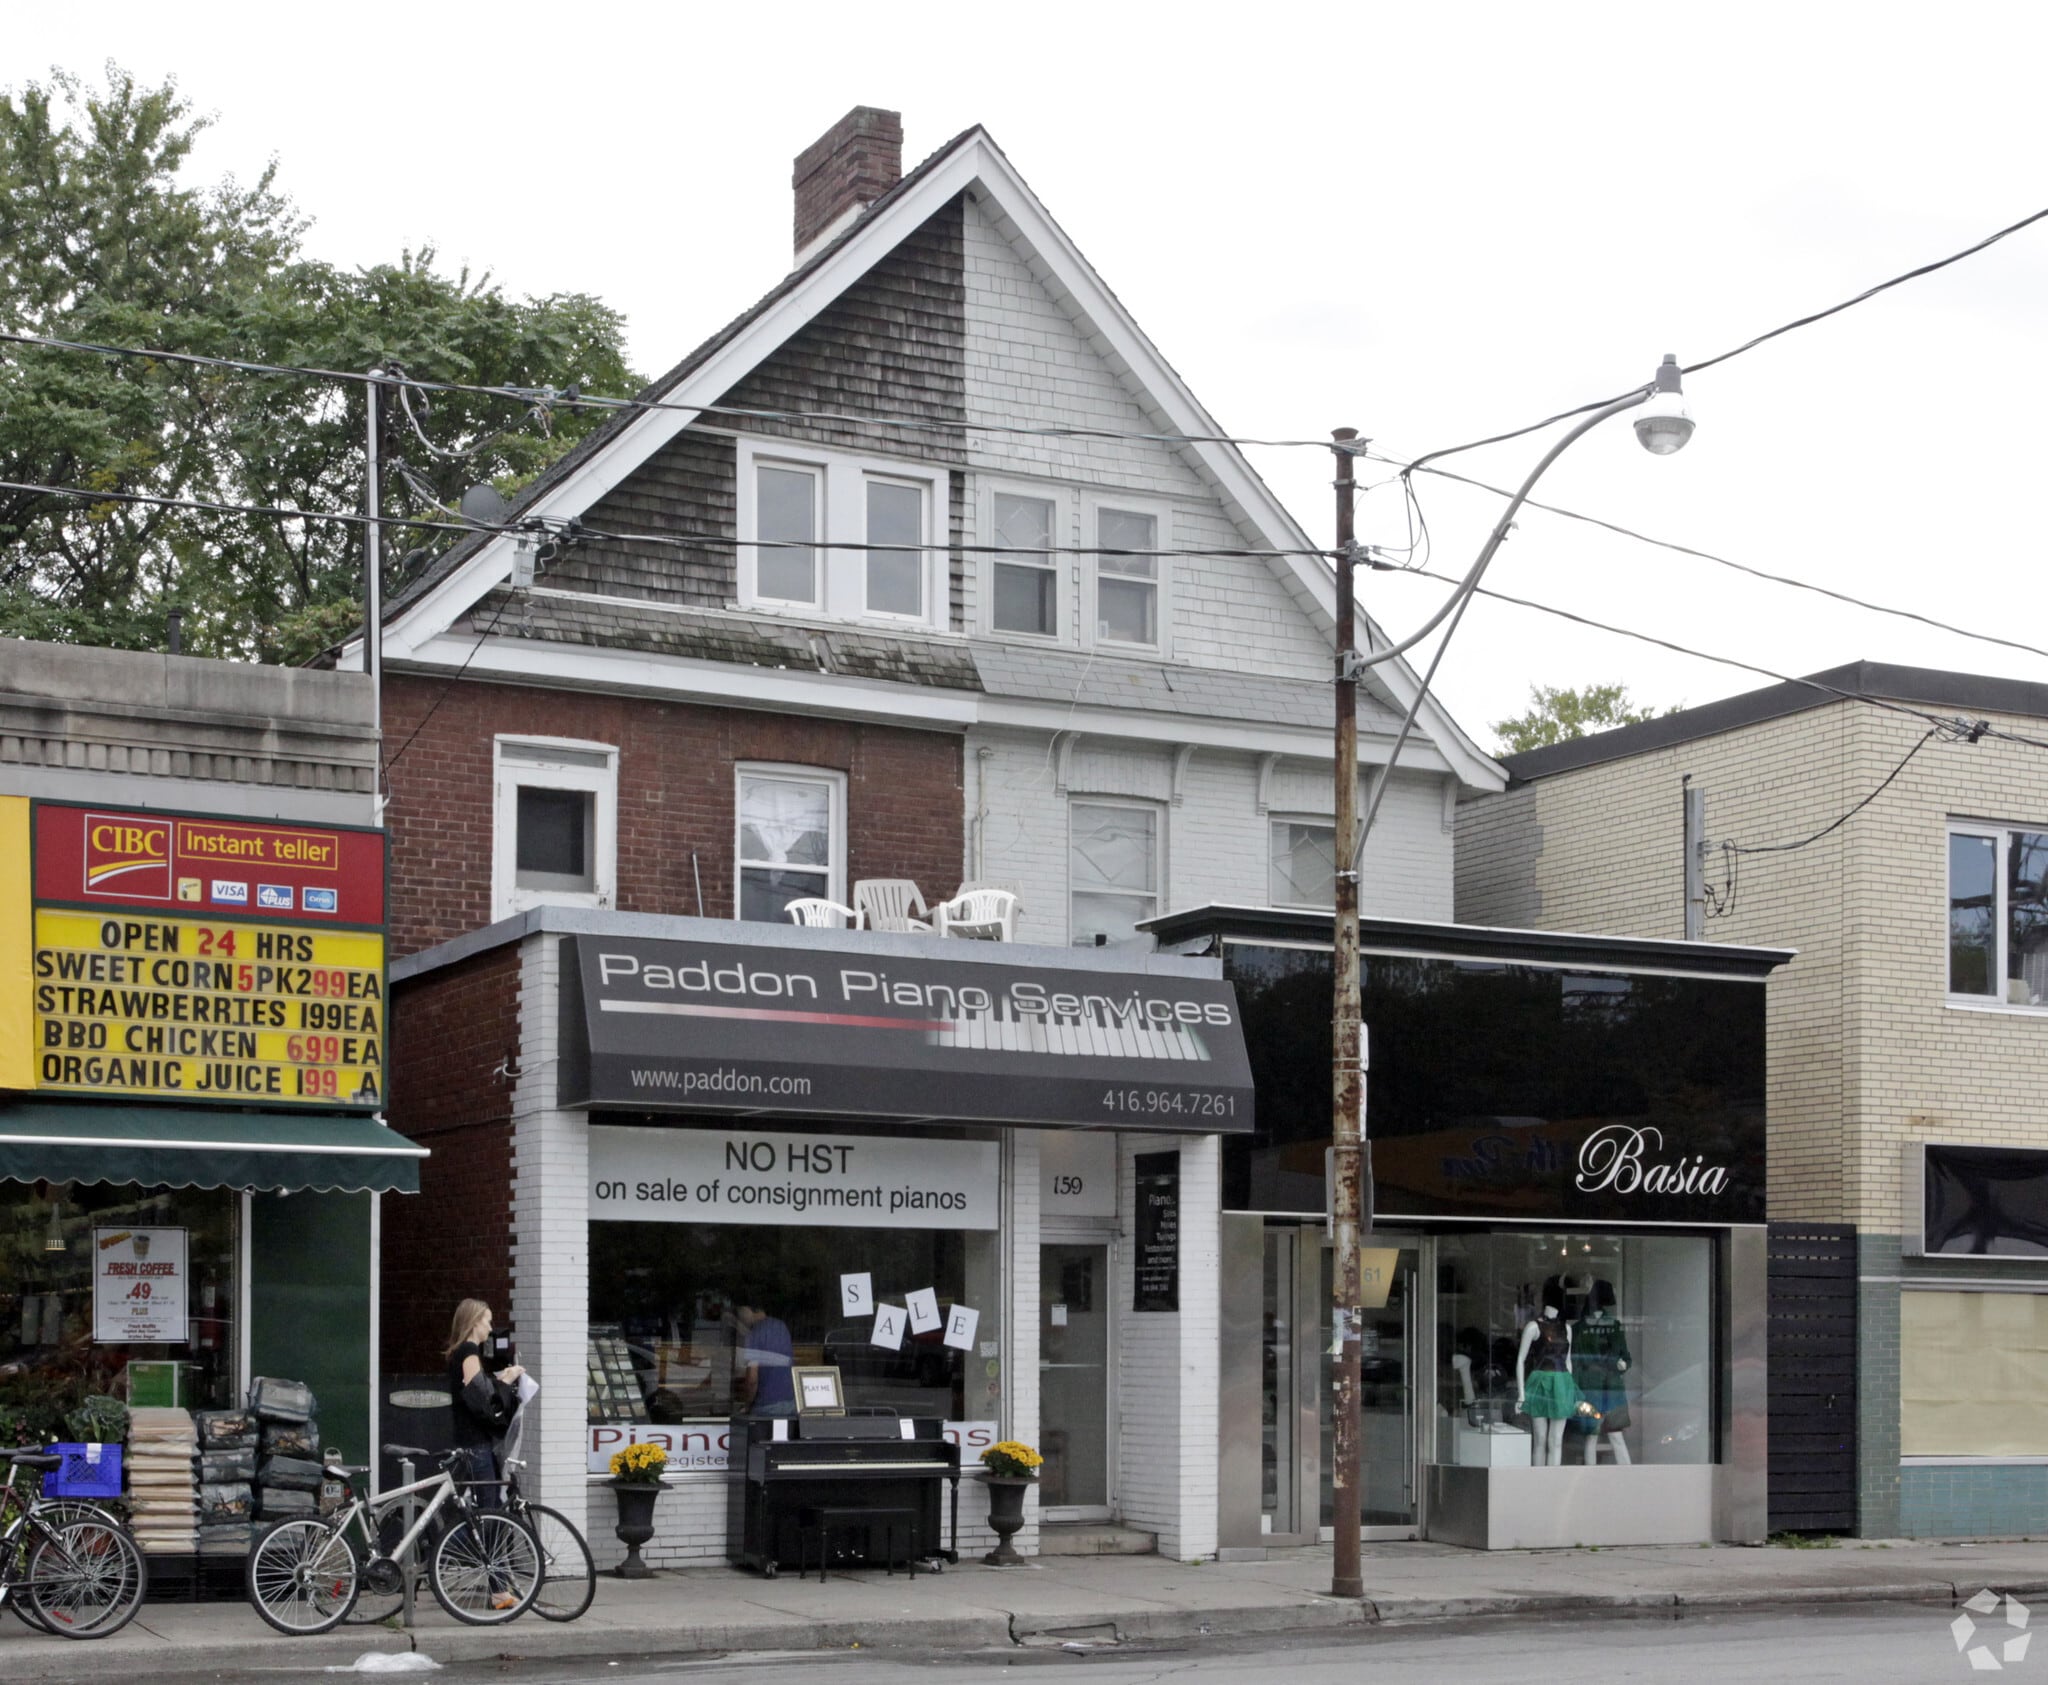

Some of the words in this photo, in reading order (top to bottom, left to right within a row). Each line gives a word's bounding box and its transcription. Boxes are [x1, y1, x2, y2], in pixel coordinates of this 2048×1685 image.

[92, 825, 165, 857] CIBC
[187, 830, 264, 857] Instant
[273, 839, 331, 861] teller
[216, 884, 246, 896] VISA
[268, 895, 291, 906] PLUS
[101, 921, 179, 953] OPEN
[198, 927, 236, 957] 24
[256, 932, 313, 962] HRS
[36, 950, 145, 984] SWEET
[37, 985, 286, 1027] STRAWBERRIES
[599, 953, 818, 999] Paddon
[840, 969, 990, 1011] Piano
[1011, 982, 1233, 1026] Services
[125, 1025, 257, 1059] CHICKEN
[42, 1053, 182, 1089] ORGANIC
[196, 1063, 281, 1093] JUICE
[631, 1067, 812, 1096] www.paddon.com
[1102, 1089, 1235, 1117] 416.964.7261
[725, 1141, 776, 1172] NO
[787, 1143, 855, 1174] HST
[1575, 1124, 1729, 1195] Basia
[595, 1180, 627, 1201] on
[635, 1177, 688, 1202] sale
[696, 1178, 720, 1203] of
[727, 1181, 883, 1212] consignment
[890, 1185, 967, 1214] pianos
[1053, 1175, 1083, 1196] 159
[107, 1262, 137, 1275] FRESH
[140, 1262, 175, 1275] COFFEE
